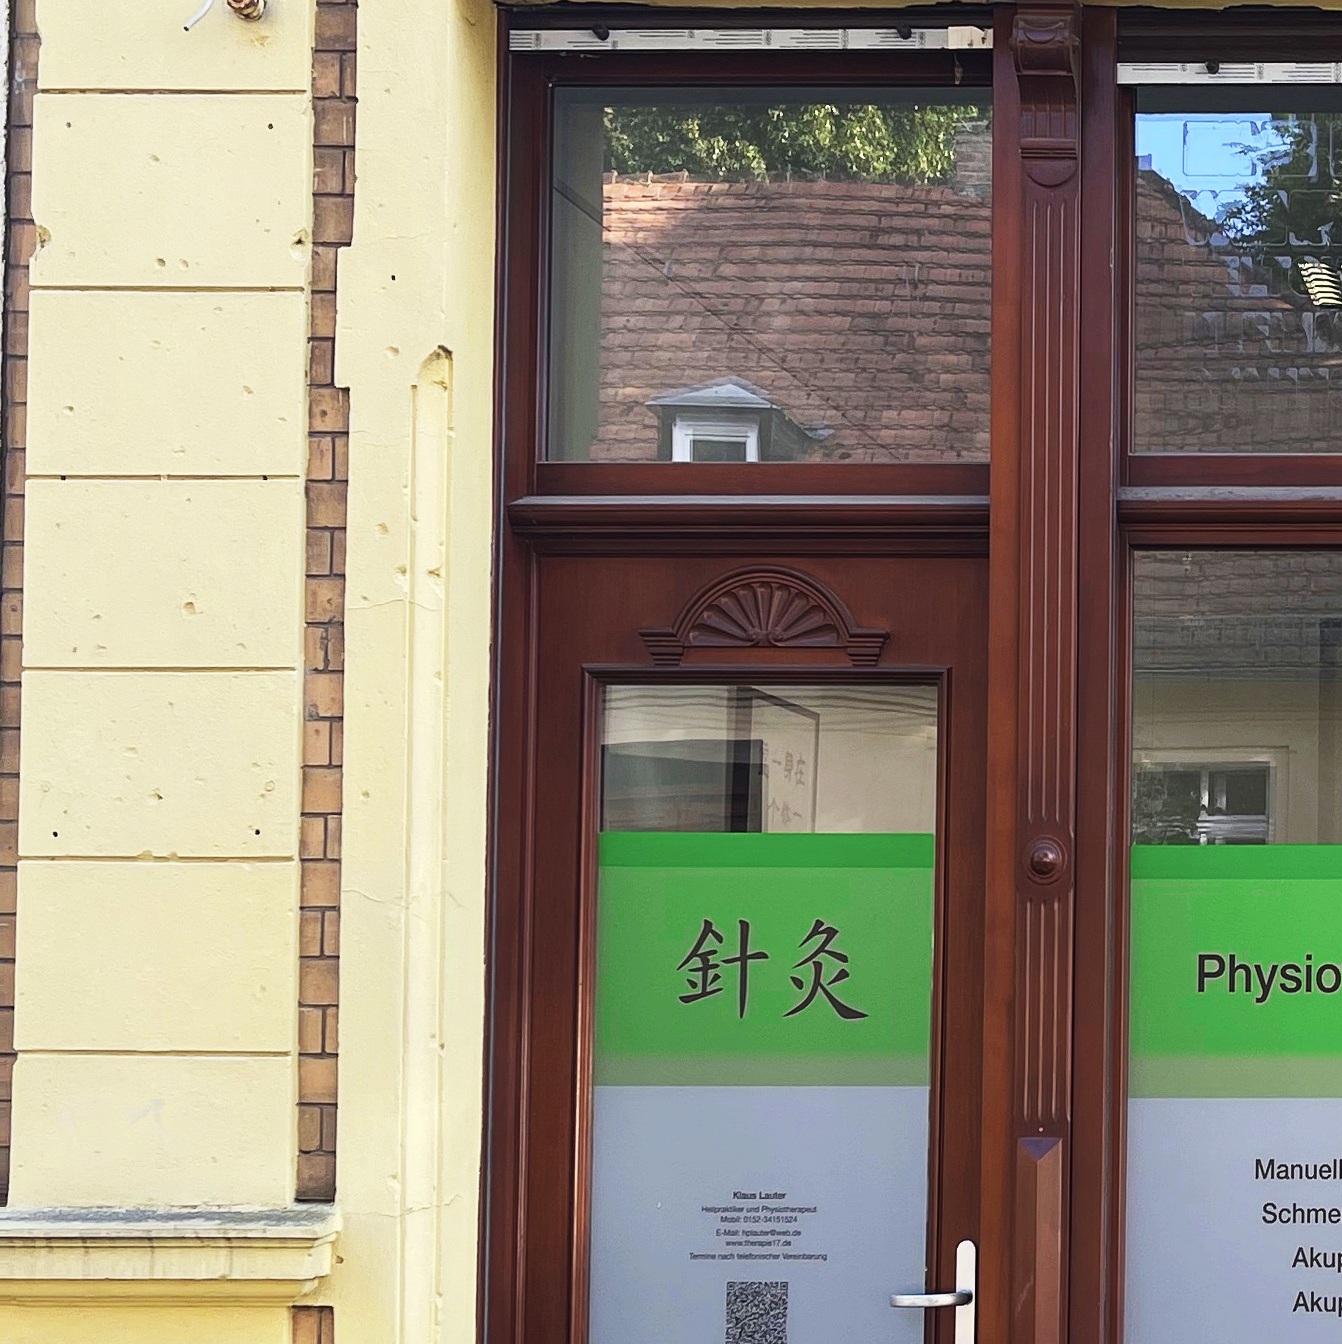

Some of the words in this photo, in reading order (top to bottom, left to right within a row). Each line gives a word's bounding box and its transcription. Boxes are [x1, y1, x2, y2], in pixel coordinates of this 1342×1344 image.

[677, 919, 868, 1019] 針灸
[732, 1190, 757, 1200] Klaus
[761, 1205, 818, 1215] Physiotherapeut
[689, 1252, 716, 1260] Termine
